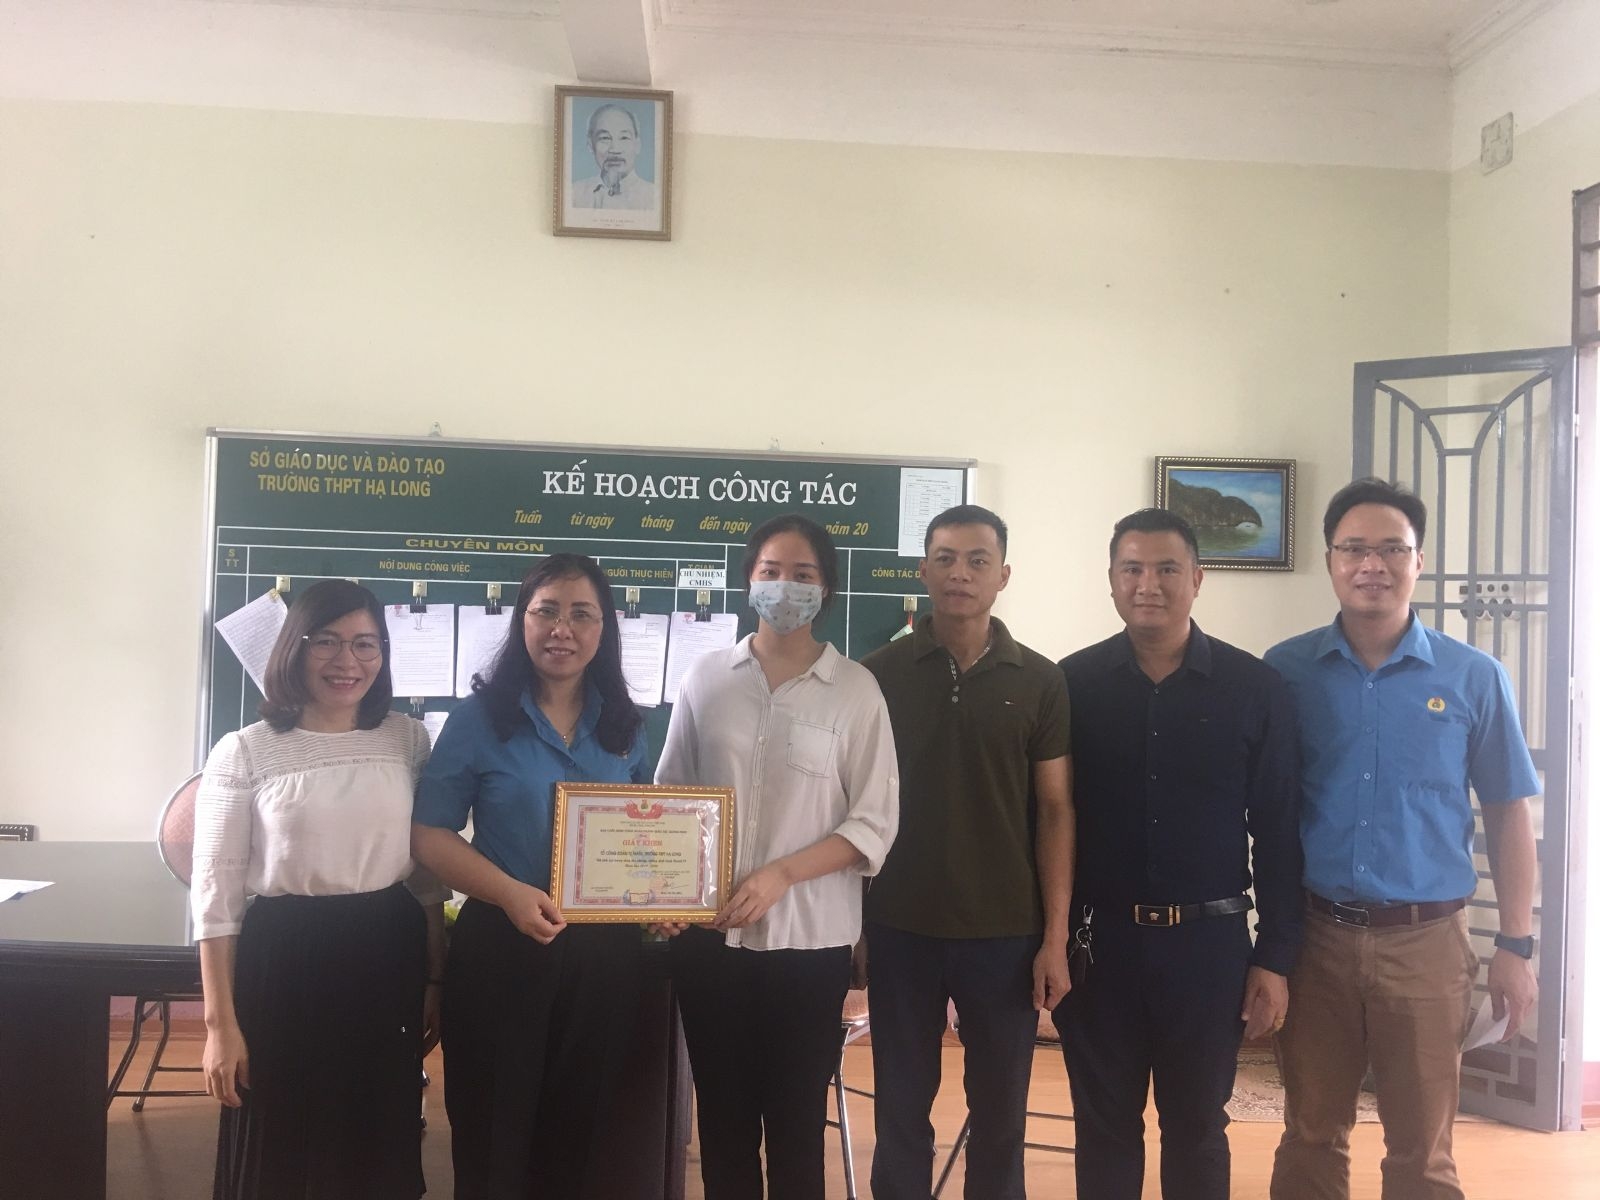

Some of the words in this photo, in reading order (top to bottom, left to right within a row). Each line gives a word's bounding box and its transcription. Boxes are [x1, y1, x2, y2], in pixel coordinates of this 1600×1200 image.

[250, 446, 270, 468] SỞ
[274, 447, 312, 470] GIÁO
[315, 453, 349, 474] DỤC
[352, 450, 374, 473] VÀ
[377, 451, 411, 474] ĐÀO
[414, 456, 445, 478] TẠO
[258, 471, 320, 493] TRƯỜNG
[324, 477, 362, 494] THPT
[365, 479, 387, 499] HẠ
[390, 480, 431, 497] LONG
[542, 459, 588, 495] KẾ
[593, 472, 701, 505] HOẠCH
[708, 470, 792, 503] CÔNG
[799, 472, 857, 506] TÁC
[514, 509, 543, 525] Tuần
[570, 511, 585, 526] từ
[585, 512, 616, 529] ngày
[641, 514, 675, 532] tháng
[699, 515, 721, 531] đến
[722, 517, 752, 534] ngày
[825, 521, 850, 536] năm
[853, 522, 869, 536] 20
[228, 548, 236, 558] S
[405, 537, 490, 551] CHUYÊN
[496, 540, 544, 552] MÔN
[397, 561, 423, 571] DUNG
[424, 559, 449, 572] CÔNG
[871, 566, 895, 579] CÔNG
[897, 567, 915, 579] TÁC
